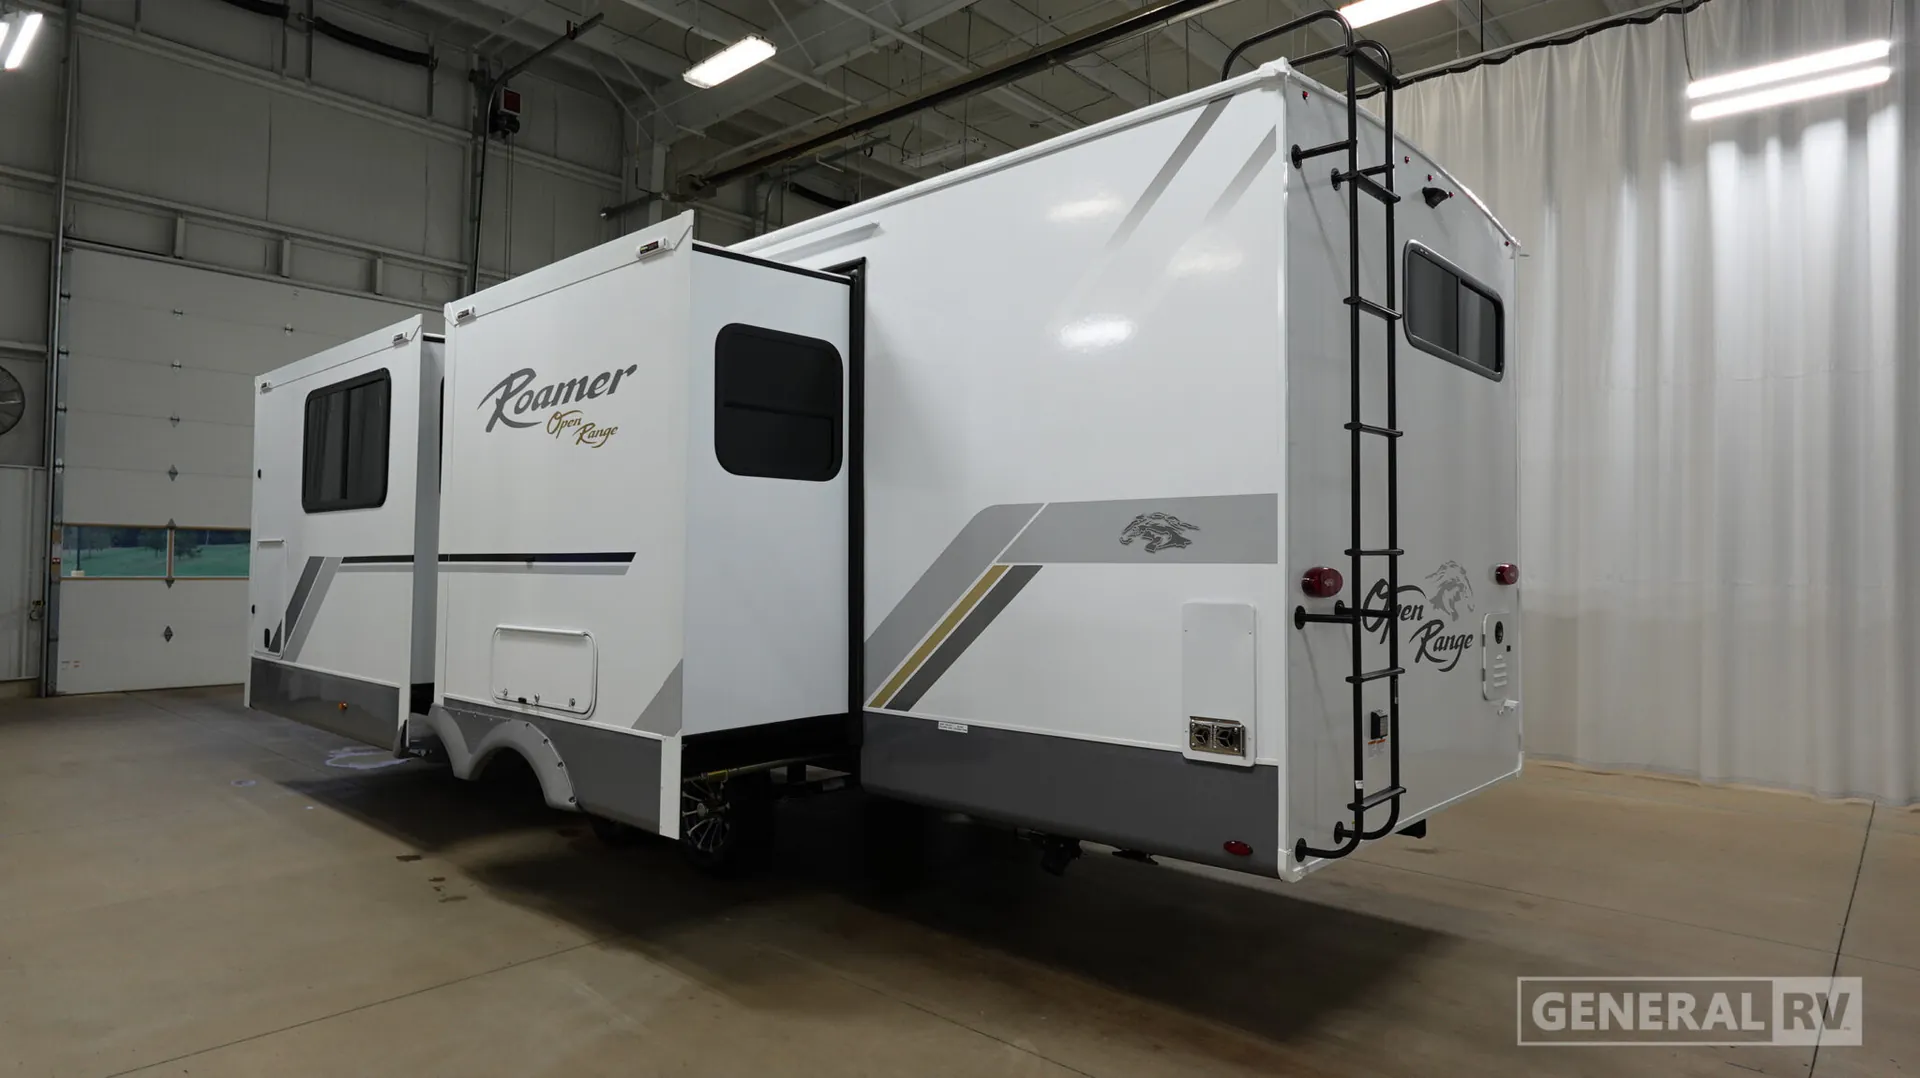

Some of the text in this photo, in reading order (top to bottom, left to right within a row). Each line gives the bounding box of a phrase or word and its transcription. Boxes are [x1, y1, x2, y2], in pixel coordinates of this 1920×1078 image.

[477, 364, 638, 433] Roamer
[546, 410, 584, 439] Open
[572, 422, 619, 448] Range
[1409, 619, 1473, 673] Range
